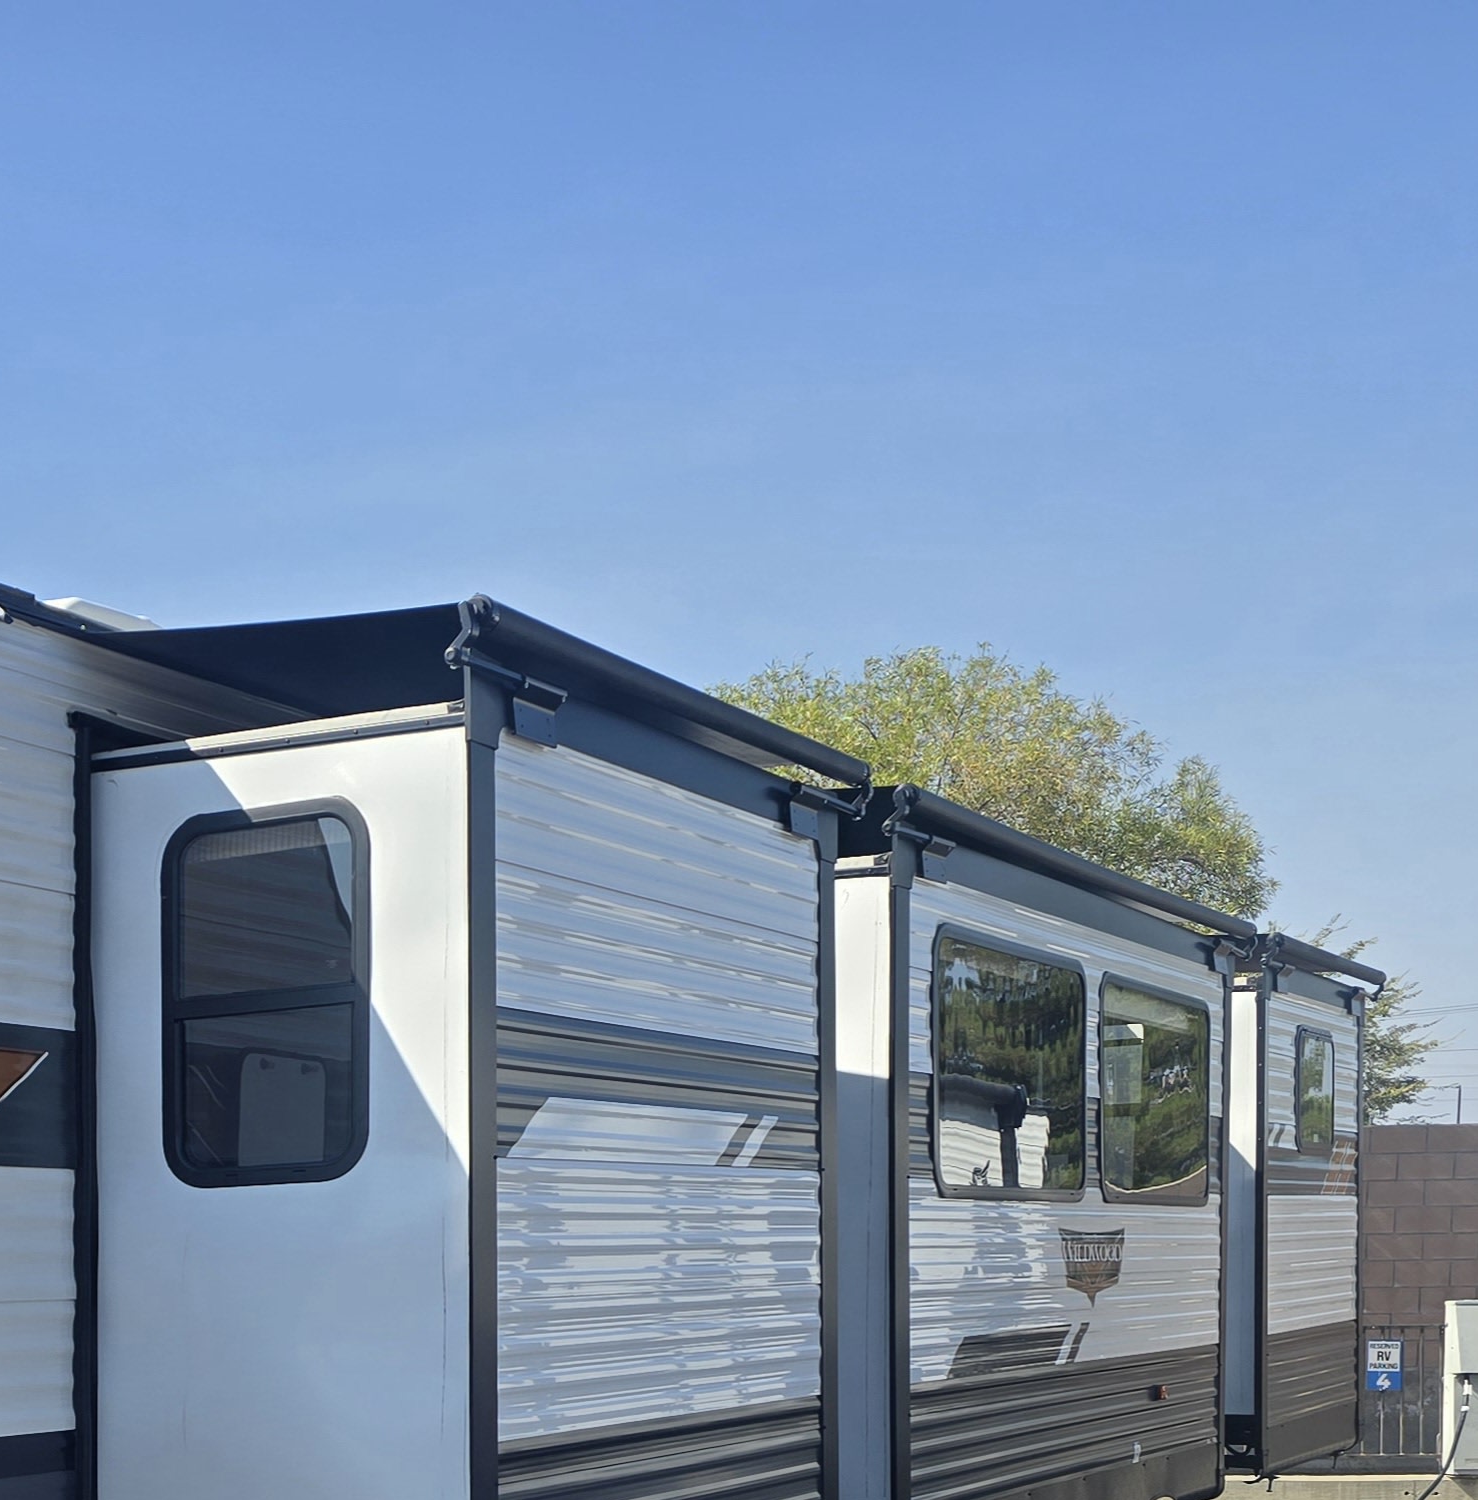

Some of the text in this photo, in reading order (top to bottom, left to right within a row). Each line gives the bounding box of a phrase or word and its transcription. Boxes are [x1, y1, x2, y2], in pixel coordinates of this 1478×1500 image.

[1062, 1240, 1122, 1262] WILDWOOD
[1377, 1351, 1392, 1361] RV
[1376, 1373, 1392, 1391] 4
